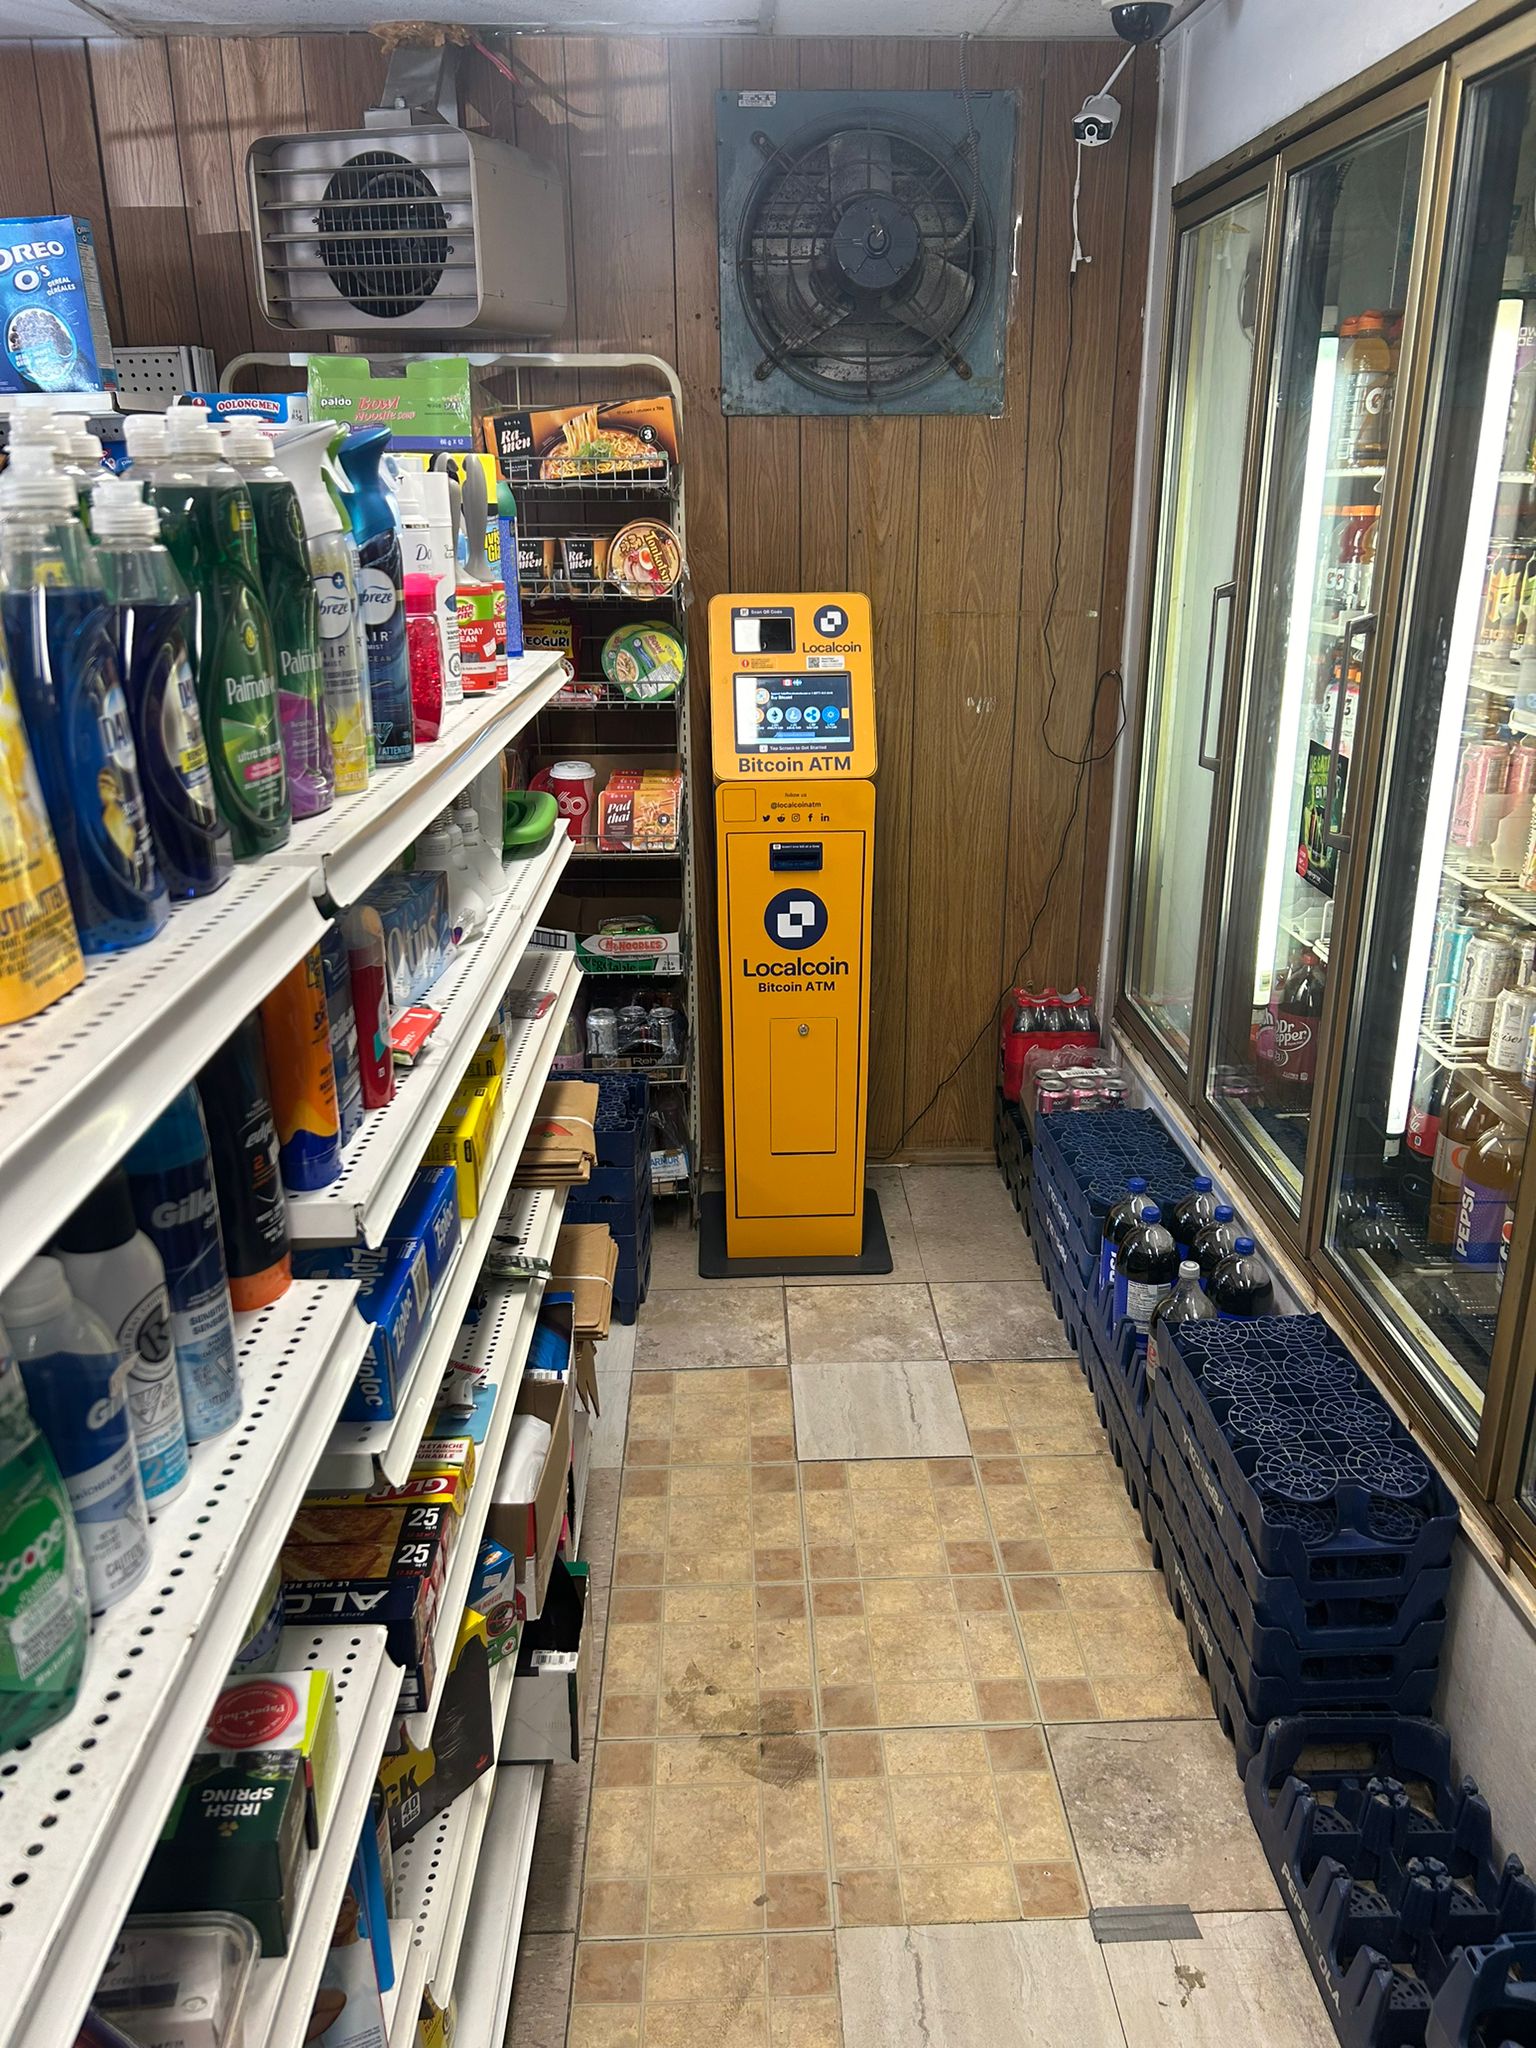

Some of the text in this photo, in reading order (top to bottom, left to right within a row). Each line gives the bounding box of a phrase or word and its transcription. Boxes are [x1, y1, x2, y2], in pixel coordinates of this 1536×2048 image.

[216, 398, 280, 412] OOLONGMEN
[321, 397, 352, 409] paldo
[502, 437, 531, 454] men
[519, 557, 543, 570] men
[569, 557, 593, 569] men
[525, 636, 570, 647] EOGURI
[802, 641, 862, 654] Localcoin
[738, 756, 851, 774] Bitcoin ATM
[770, 801, 822, 809] @localcoinatm
[620, 940, 662, 951] NOODLES
[743, 956, 849, 978] Localcoin
[758, 981, 835, 993] Bitcoin ATM
[1280, 1019, 1295, 1034] Dr
[1455, 1185, 1477, 1258] PEPSI
[408, 1507, 440, 1526] 25
[398, 1543, 430, 1563] 25
[283, 1590, 389, 1614] ALC
[201, 1786, 275, 1802] SPRING
[205, 1802, 262, 1817] IRISH
